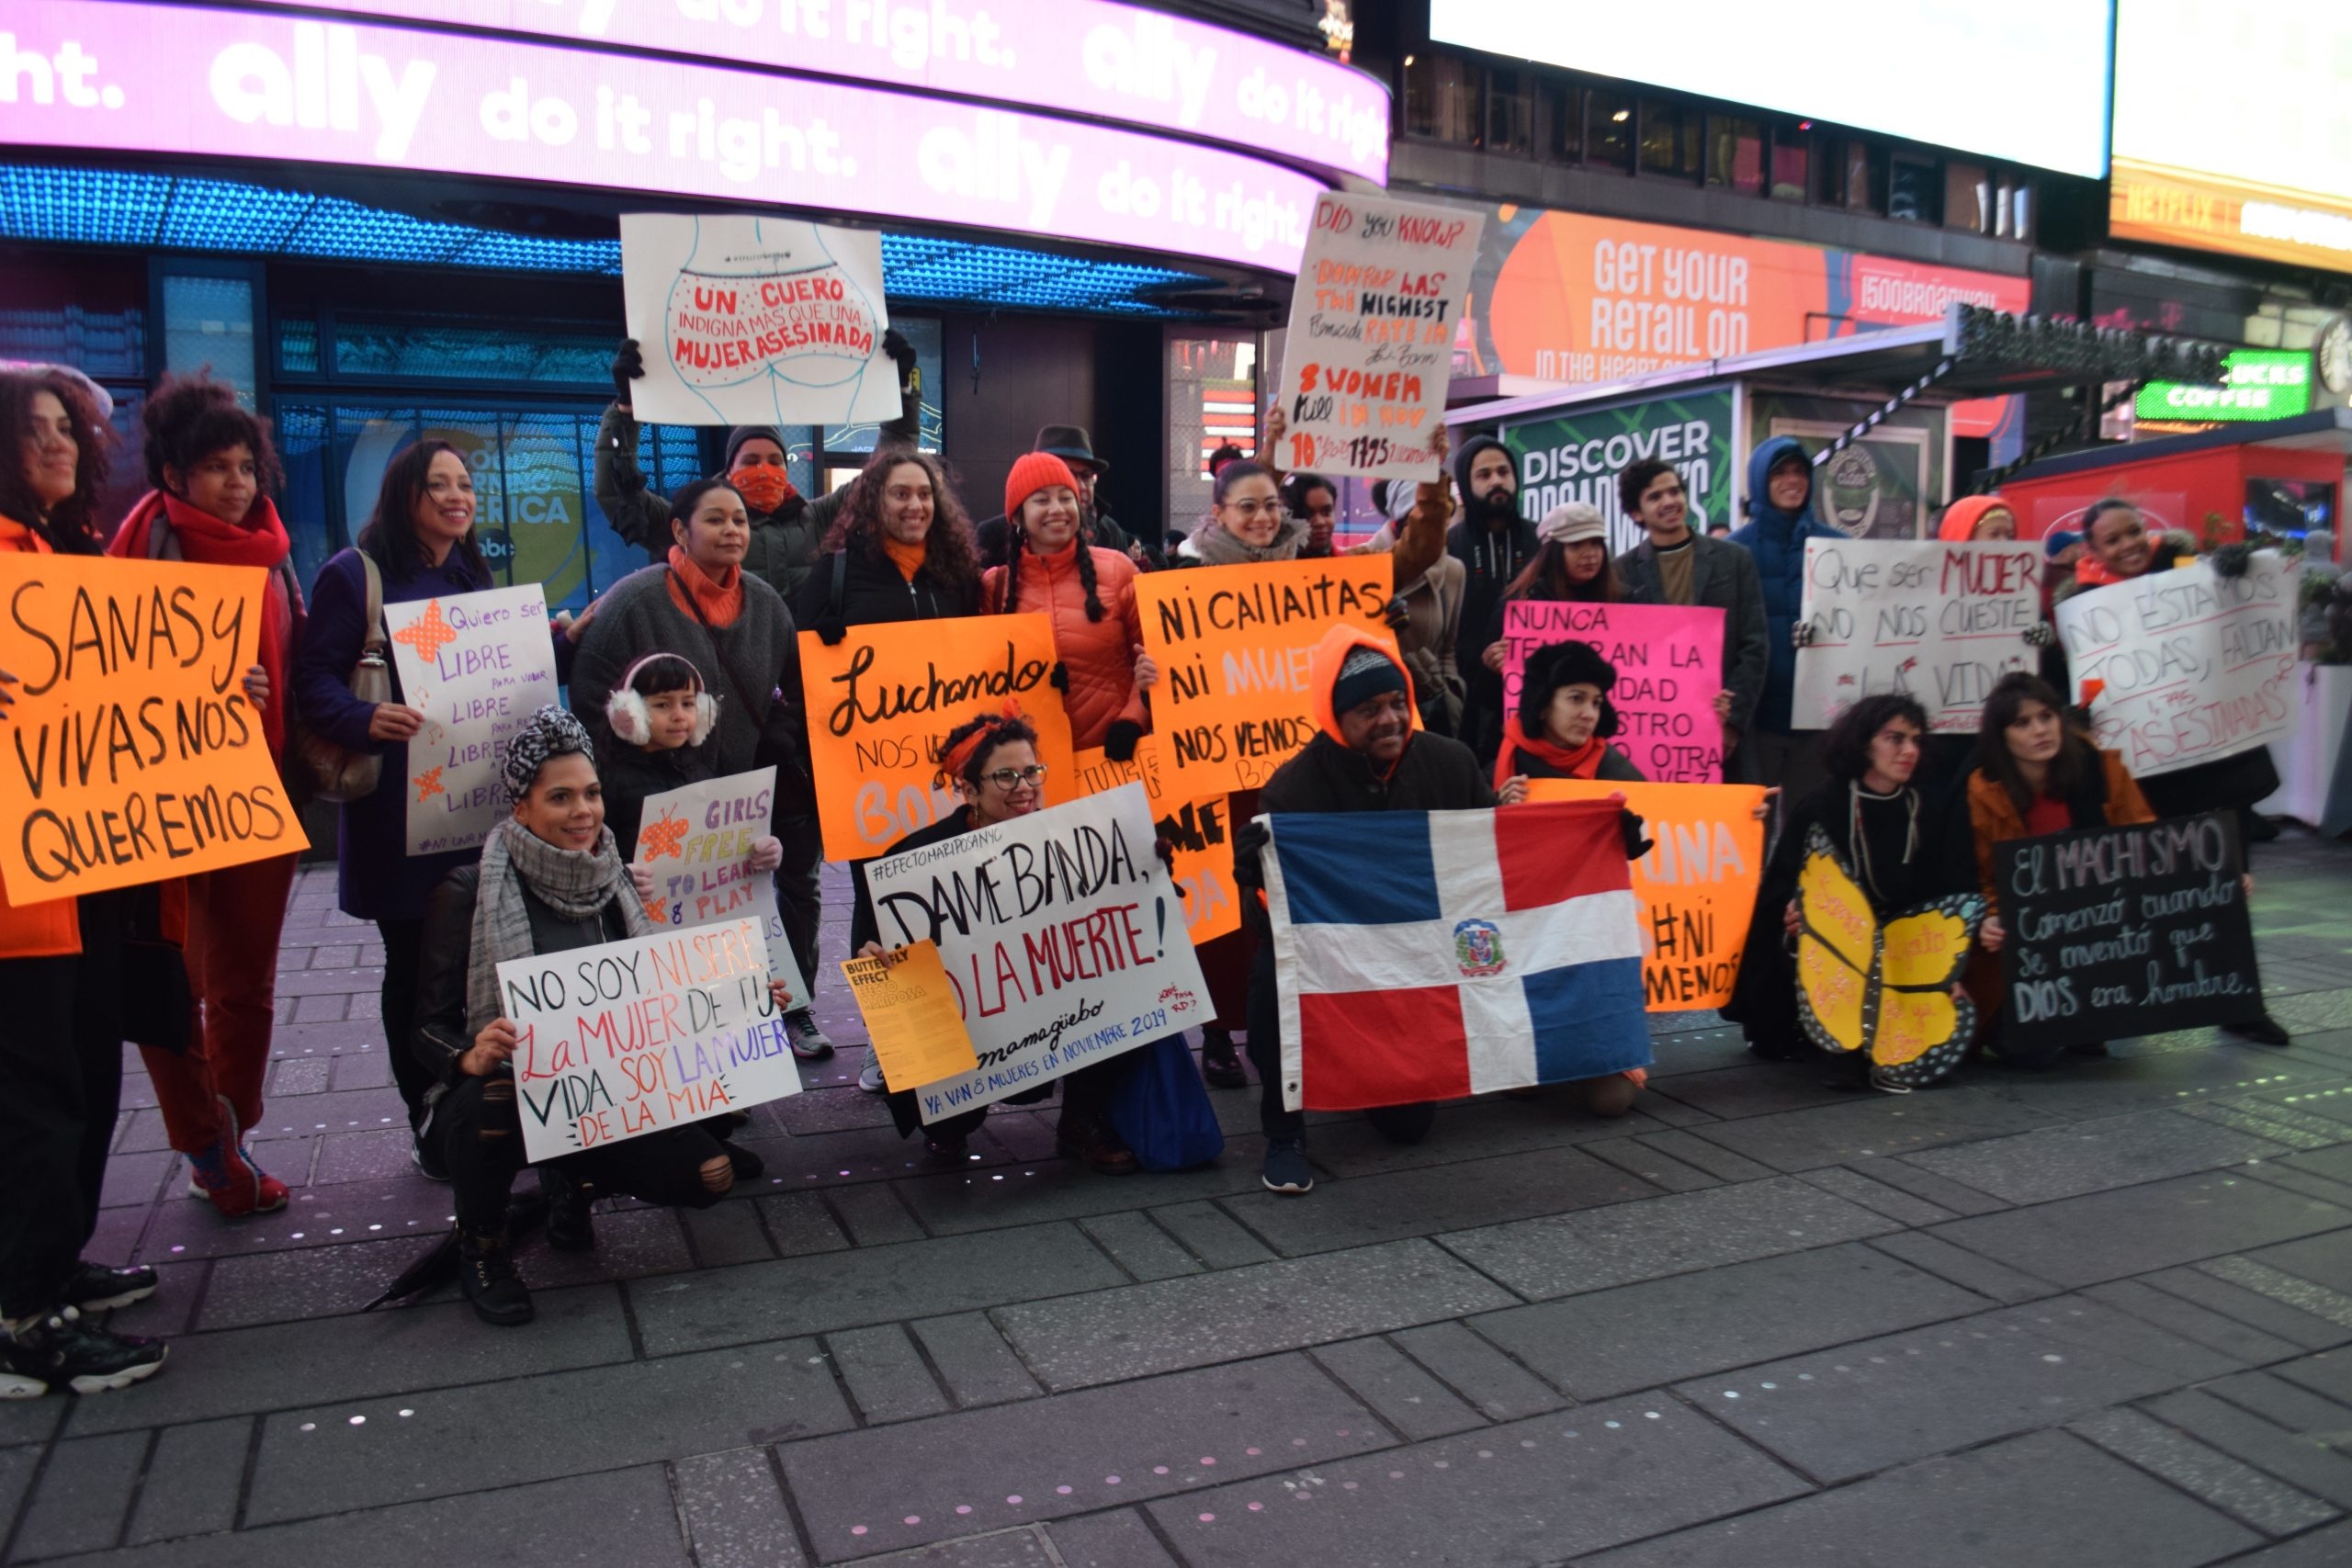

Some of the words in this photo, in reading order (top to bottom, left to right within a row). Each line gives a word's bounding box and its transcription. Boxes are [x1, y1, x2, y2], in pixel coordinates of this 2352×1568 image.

[1081, 11, 1218, 128] ally
[1237, 65, 1287, 124] do
[1295, 78, 1325, 135] it
[208, 23, 437, 162] ally
[479, 77, 578, 147] do
[595, 86, 652, 154] it
[668, 96, 858, 183] right.
[917, 110, 1071, 230] ally
[1096, 160, 1161, 219] do
[1170, 167, 1205, 227] it
[1317, 199, 1353, 233] DID
[1396, 213, 1465, 249] KNOW?
[2126, 183, 2213, 231] NETFLIX
[695, 286, 737, 315] UN
[760, 276, 844, 309] CUERO
[679, 311, 748, 338] INDIGNA
[788, 303, 824, 323] QUE
[830, 304, 862, 327] UNA
[675, 337, 756, 369] MUJER
[755, 321, 873, 359] ASESINADA
[1299, 363, 1320, 394] 8
[2166, 388, 2269, 408] COFFEE
[1289, 431, 1316, 468] 10
[1523, 420, 1710, 485] DISCOVER
[474, 495, 571, 524] ERICA
[1939, 548, 2041, 596] MUJER
[11, 580, 205, 696] SANAS
[448, 605, 511, 632] Quiero
[520, 601, 545, 618] ser
[1510, 604, 1610, 632] NUNCA
[1810, 607, 1853, 640] NO
[1875, 604, 1928, 643] NOS
[1939, 598, 2031, 636] CUESTE
[2067, 605, 2123, 653] NO
[436, 643, 513, 682] LIBRE
[1670, 643, 1703, 669] LA
[451, 696, 511, 725] LIBRE
[828, 639, 1049, 737] Luchando
[175, 694, 250, 761] NOS
[1171, 723, 1228, 769] NOS
[1234, 715, 1317, 759] VEMOS
[855, 735, 918, 773] NOS
[1650, 743, 1723, 771] OTRA
[705, 789, 770, 829] GIRLS
[22, 784, 286, 884] QUEREMOS
[684, 827, 754, 866] FREE
[1638, 819, 1745, 886] UNA
[2055, 818, 2225, 890] MACHISMO
[666, 874, 695, 898] TO
[695, 882, 754, 919] PLAY
[507, 970, 566, 1019] NO
[650, 939, 694, 991] NI
[845, 949, 910, 975] BUTTEFLY
[851, 969, 890, 987] EFFECT
[971, 940, 1027, 1018] LA
[687, 984, 729, 1034] DE
[861, 985, 927, 1010] MARIPOSA
[2013, 976, 2079, 1023] DIOS
[620, 1047, 669, 1101] SOY
[673, 1041, 714, 1085] LA
[712, 1018, 791, 1073] MUJER
[924, 1095, 944, 1116] YA
[945, 1081, 974, 1109] VAN
[987, 1061, 1040, 1092] MUJERES
[1044, 1050, 1059, 1071] EN
[1063, 1023, 1128, 1059] NOVIEMBRE
[1131, 1007, 1168, 1038] 2019
[578, 1110, 615, 1147] DE
[621, 1100, 657, 1134] LA
